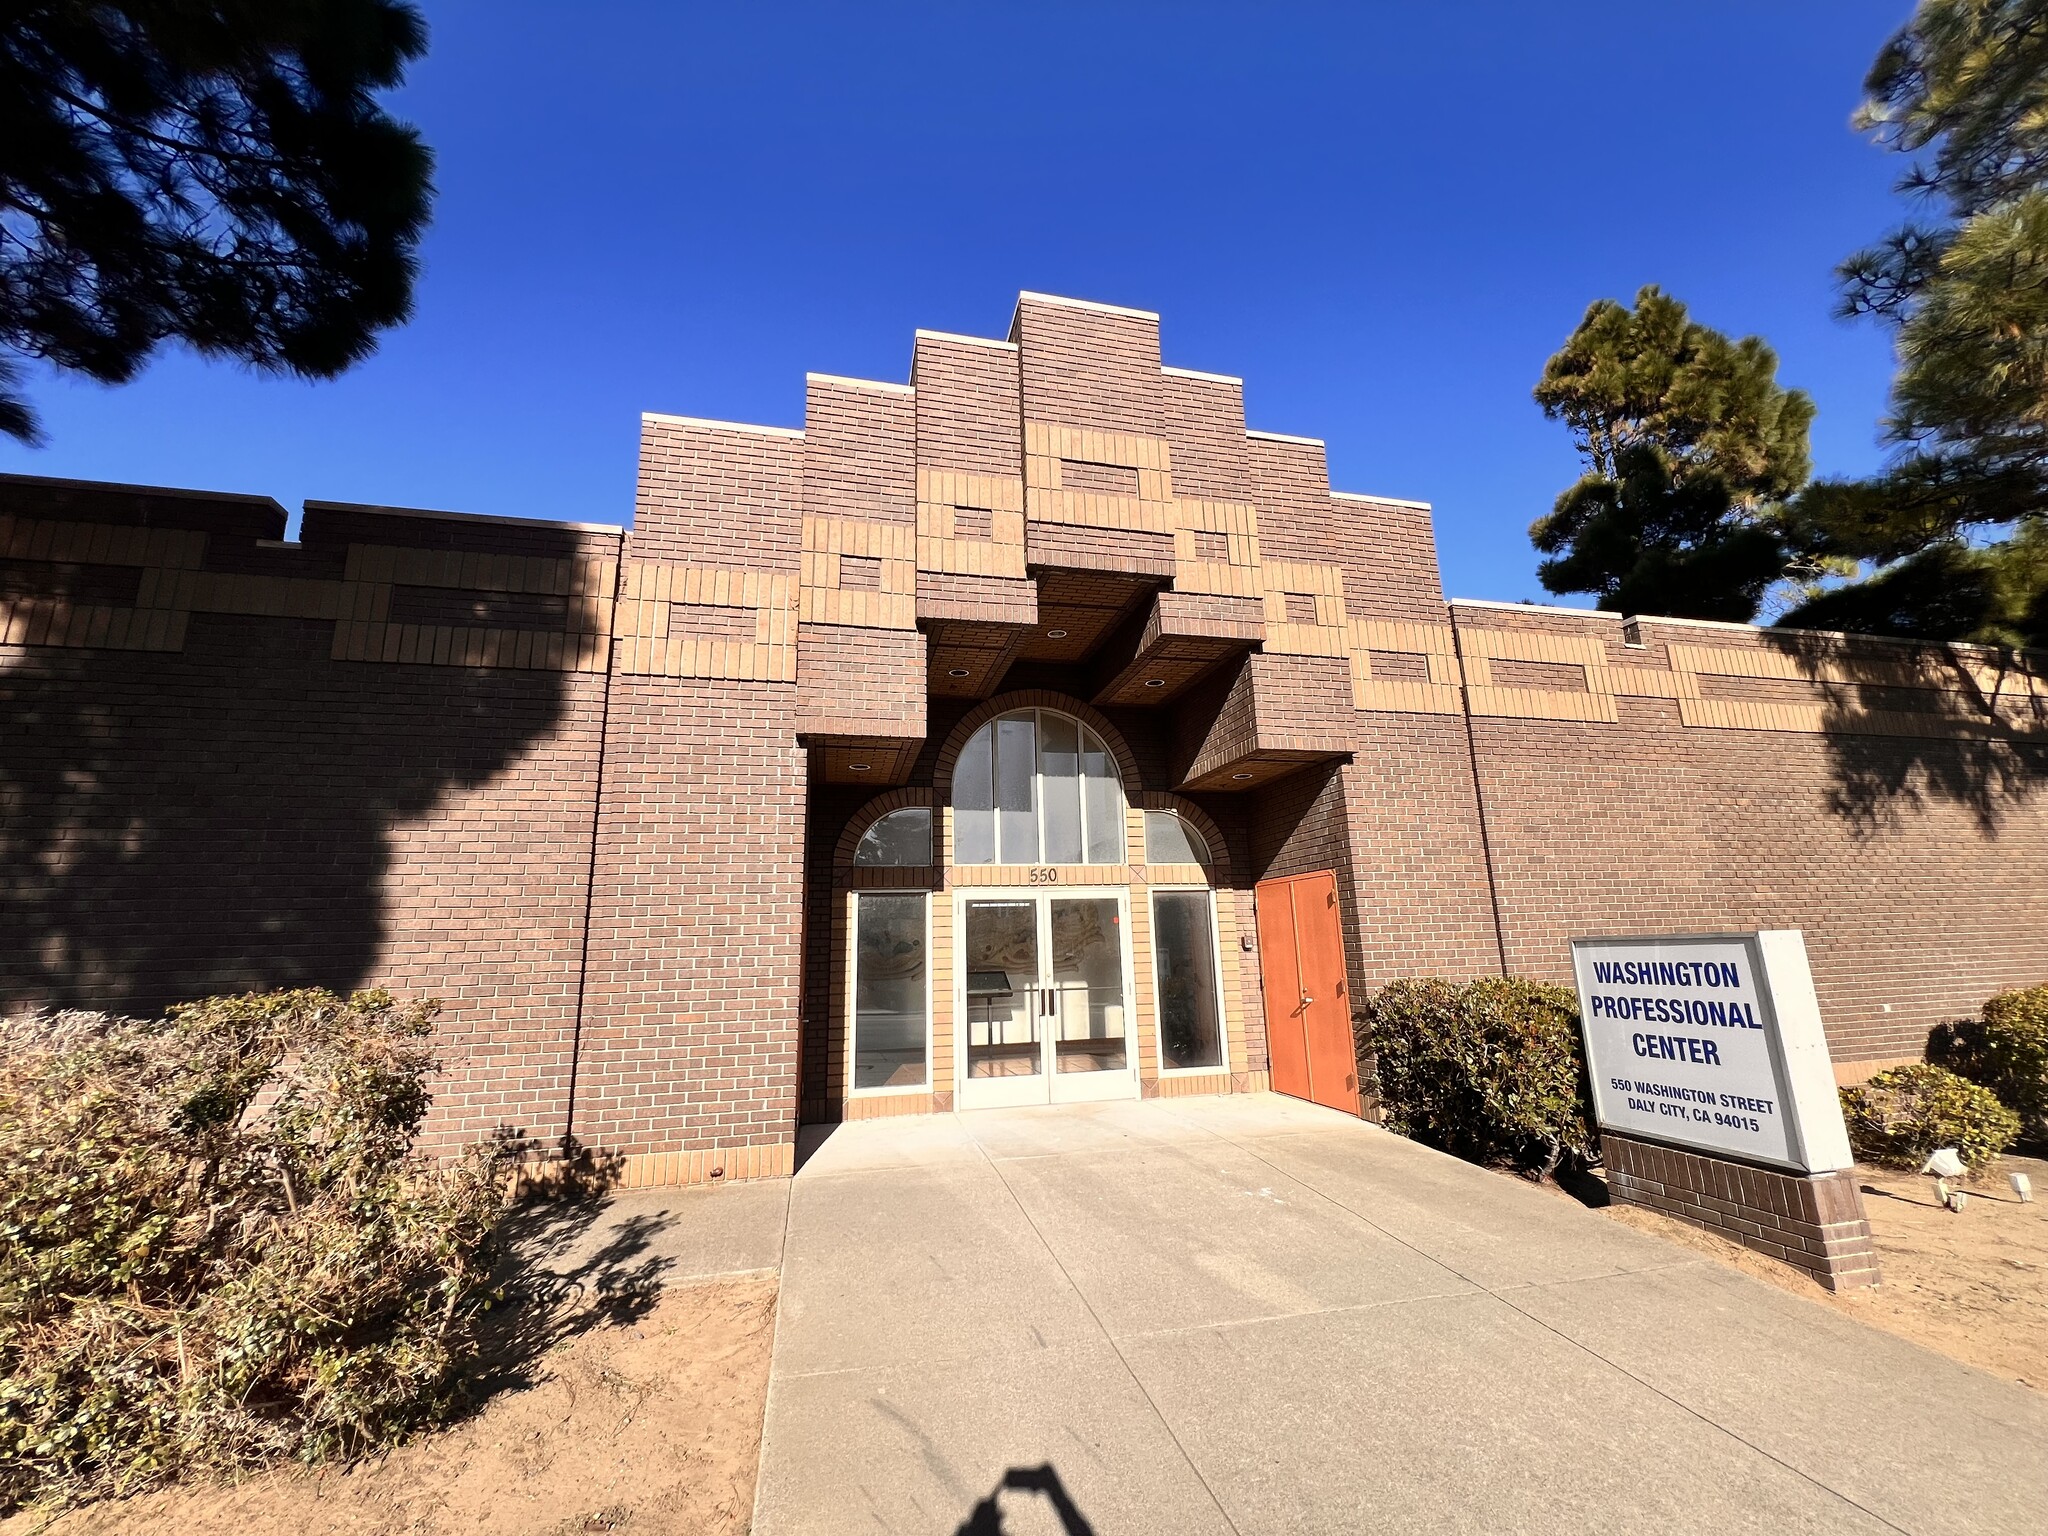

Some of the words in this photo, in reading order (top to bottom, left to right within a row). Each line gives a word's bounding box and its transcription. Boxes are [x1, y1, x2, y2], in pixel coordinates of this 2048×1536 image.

[1030, 868, 1057, 883] 550
[1592, 961, 1740, 988] WASHINGTON
[1590, 995, 1763, 1030] PROFESSIONAL
[1632, 1032, 1721, 1066] CENTER
[1611, 1078, 1632, 1092] 550
[1634, 1081, 1717, 1106] WASHINGTON
[1719, 1094, 1774, 1115] STREET
[1627, 1097, 1655, 1113] DALY
[1660, 1102, 1690, 1122] CITY,
[1693, 1108, 1712, 1124] CA
[1714, 1112, 1760, 1133] 94015
